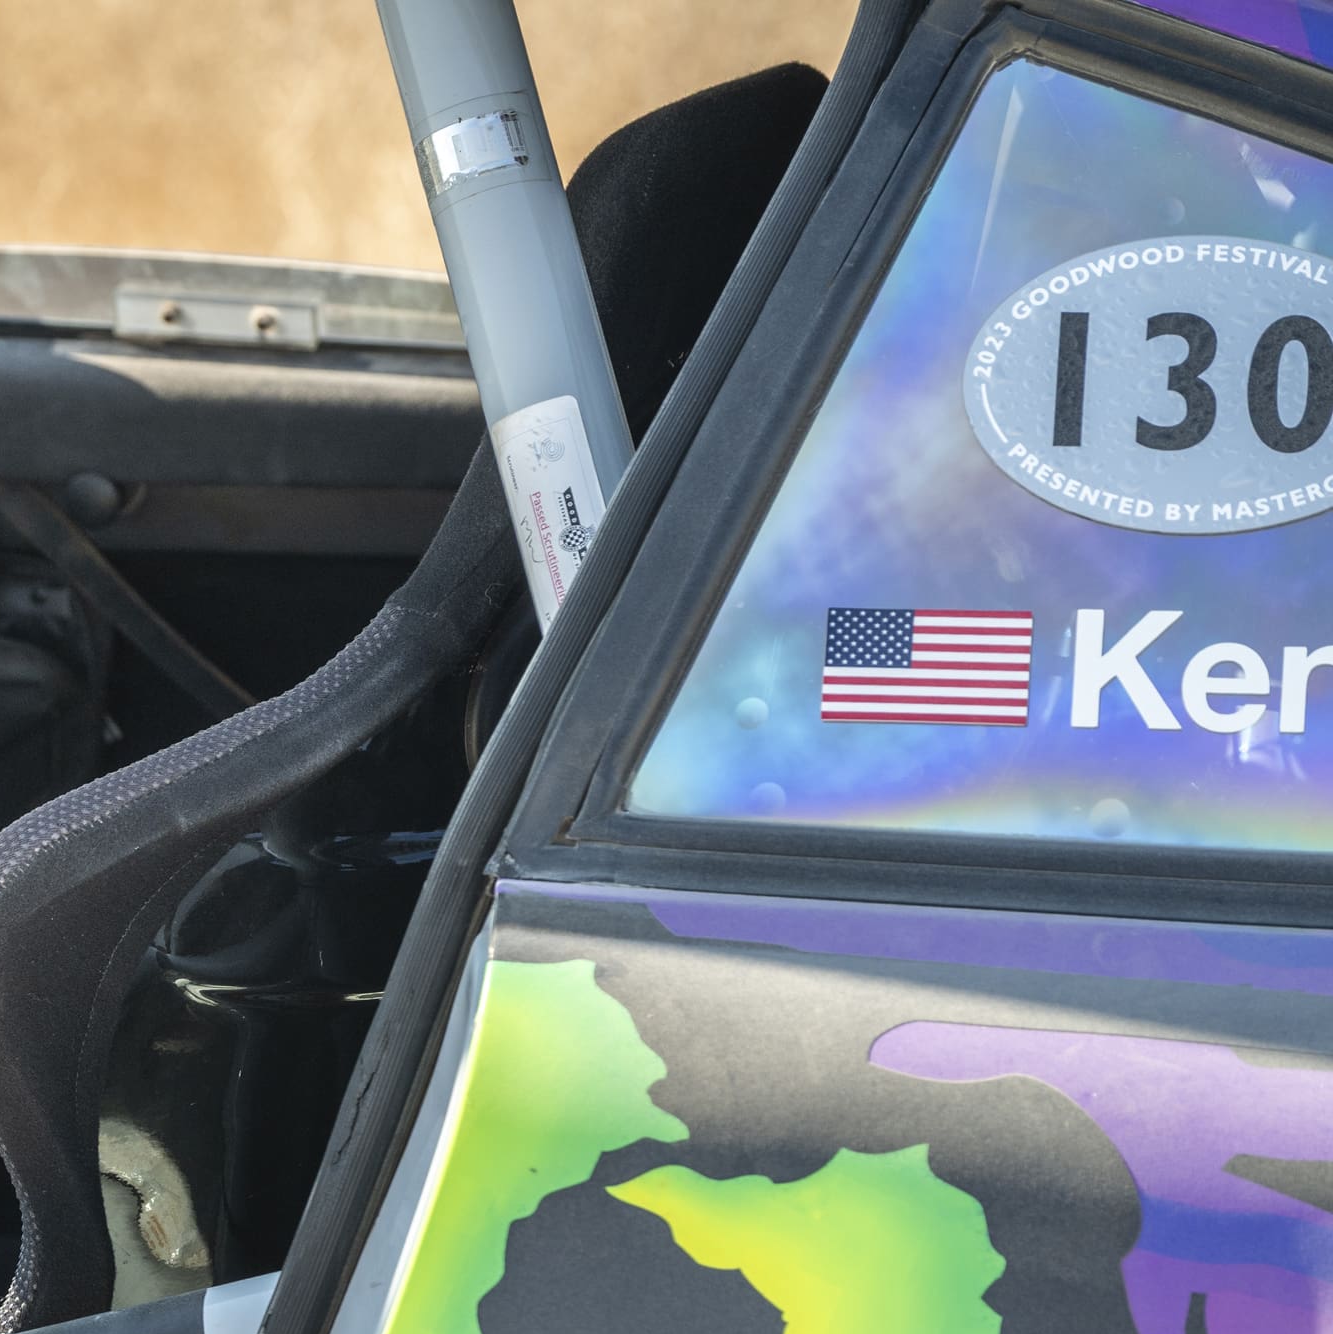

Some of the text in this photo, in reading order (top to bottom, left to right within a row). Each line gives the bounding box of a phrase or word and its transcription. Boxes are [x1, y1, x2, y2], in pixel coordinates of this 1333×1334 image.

[973, 244, 1328, 379] 2023 GOODWOOD FESTIVAL
[1052, 311, 1333, 454] 130
[1007, 443, 1155, 518] PRESENTED
[1164, 503, 1201, 521] BY
[532, 491, 550, 531] Passed
[542, 532, 567, 606] Scrutineerin
